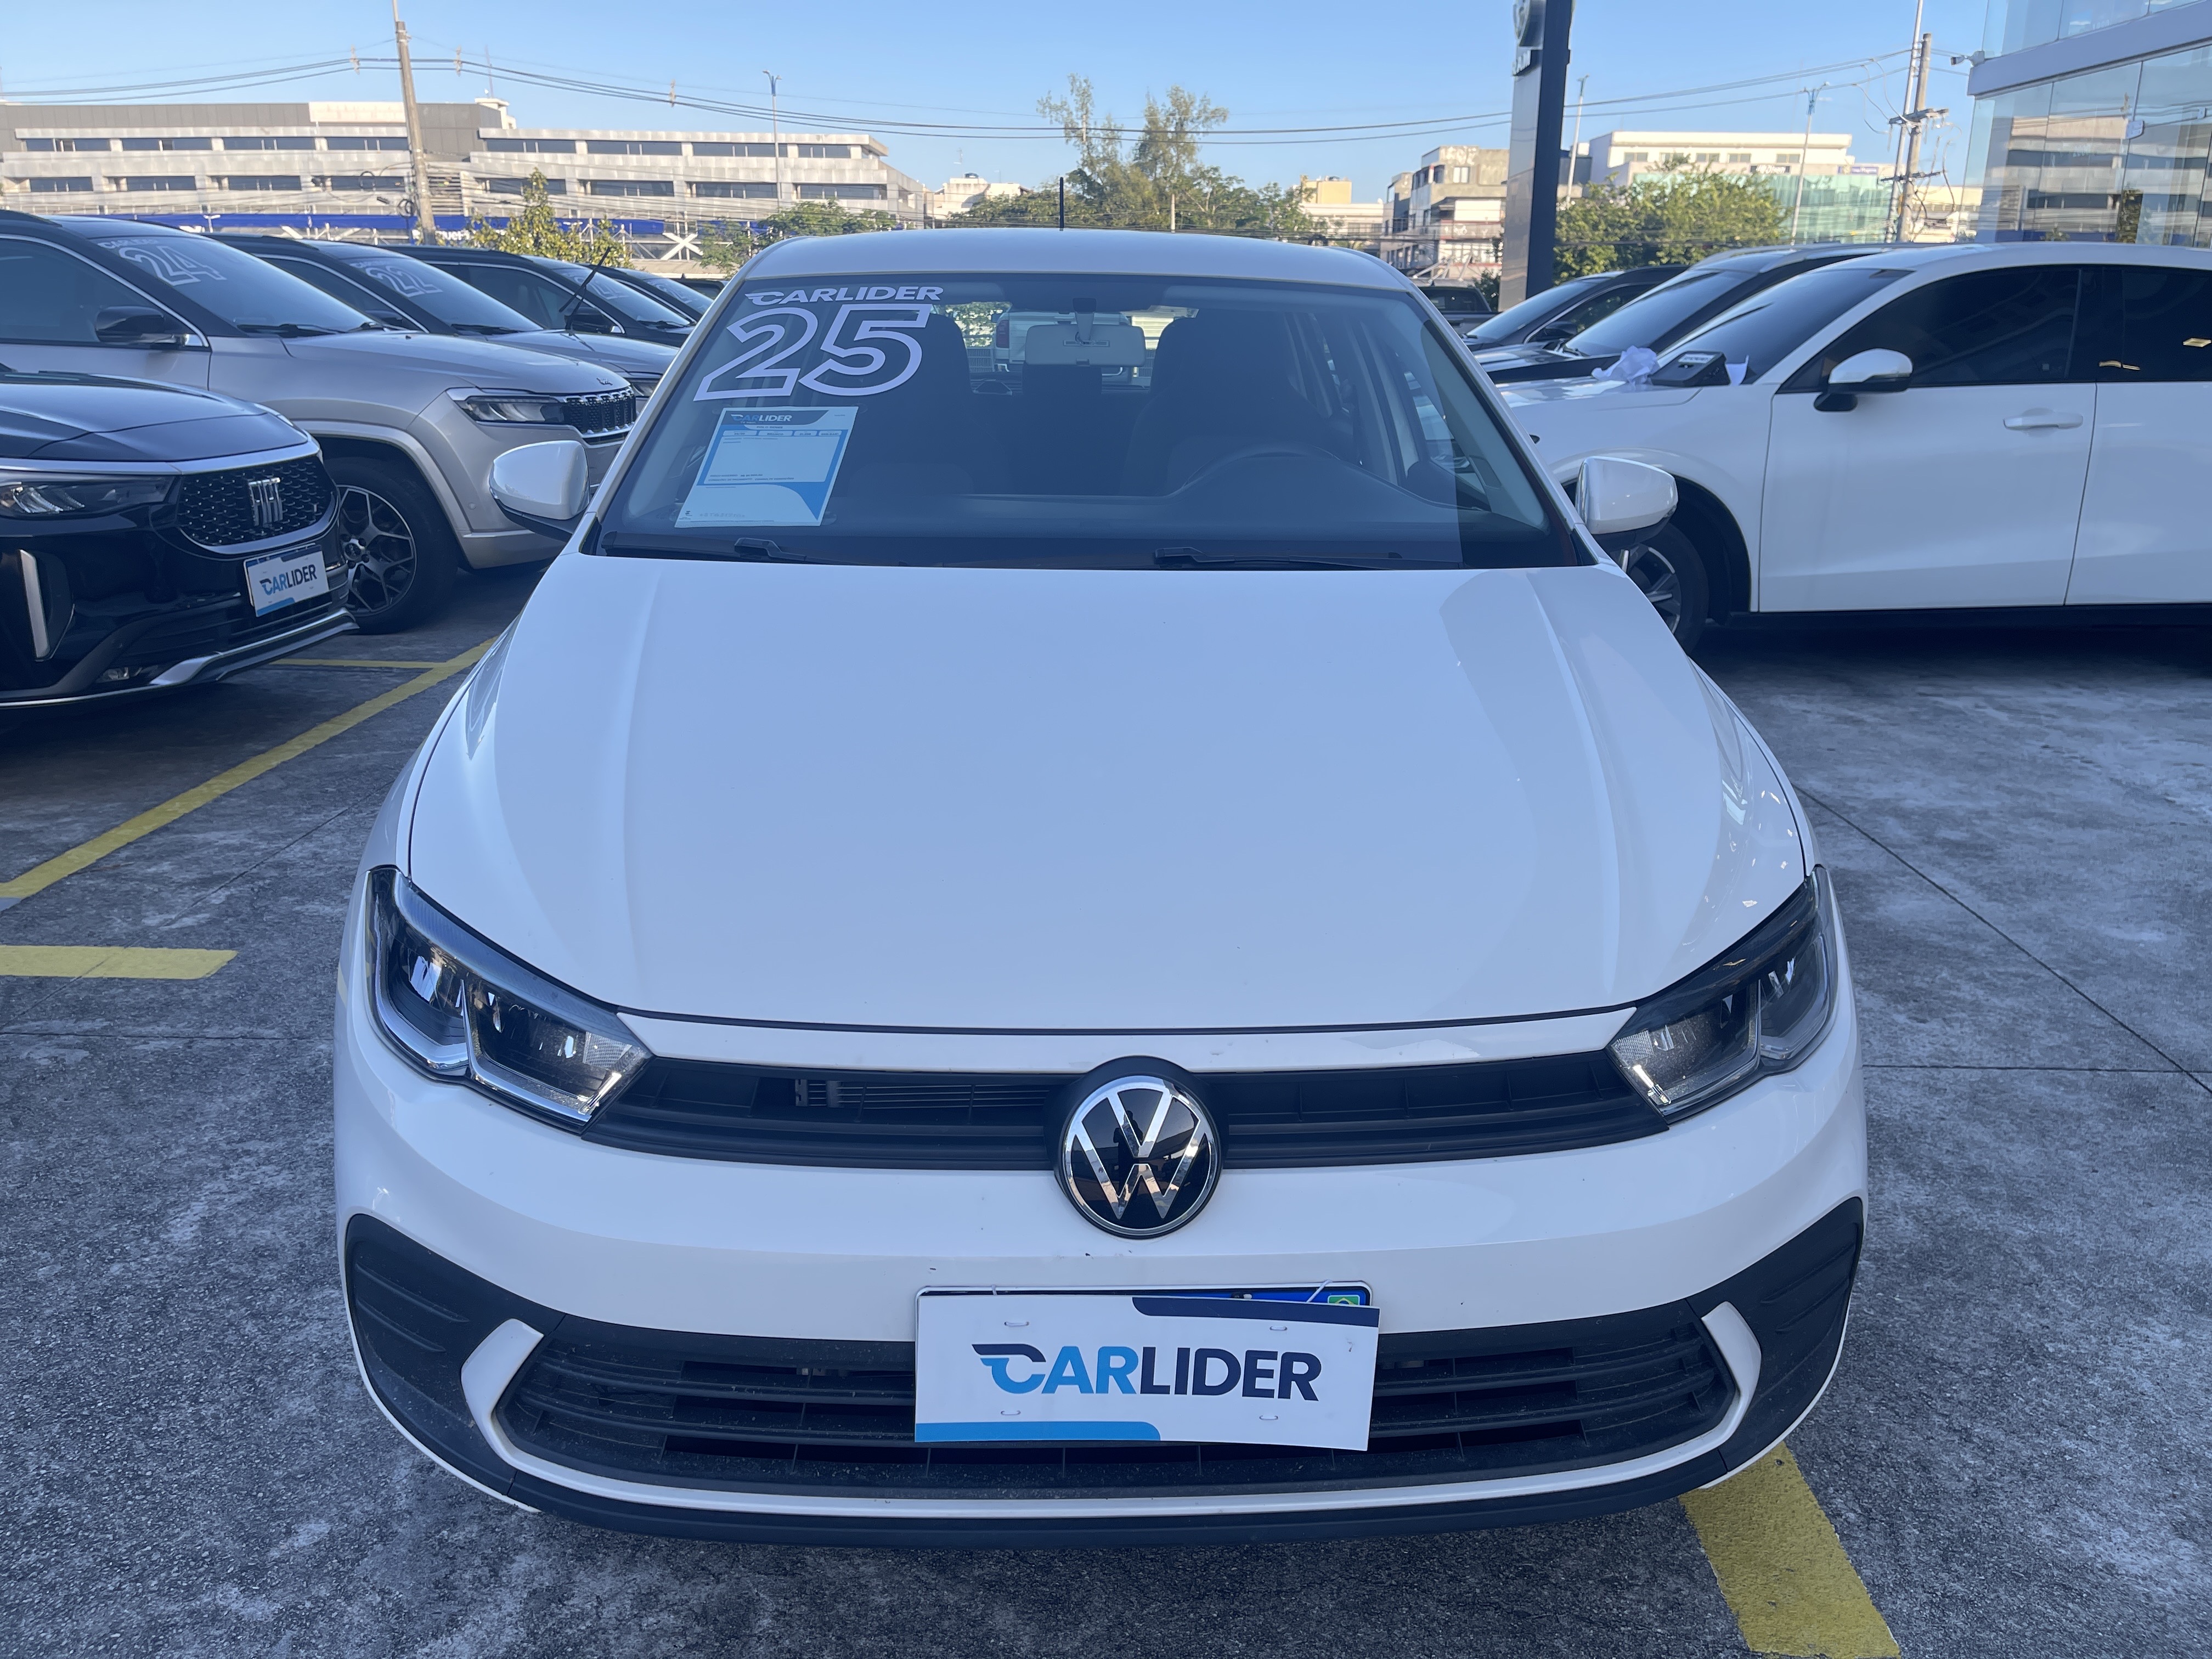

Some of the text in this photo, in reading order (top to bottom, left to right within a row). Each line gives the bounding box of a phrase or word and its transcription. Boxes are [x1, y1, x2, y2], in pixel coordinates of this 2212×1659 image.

[118, 246, 227, 286] 24
[744, 286, 944, 306] CARLIDER
[693, 303, 932, 402] 25
[730, 414, 793, 422] CARLIDER
[259, 563, 318, 596] CARLIDER
[971, 1343, 1322, 1402] CARLIDER
